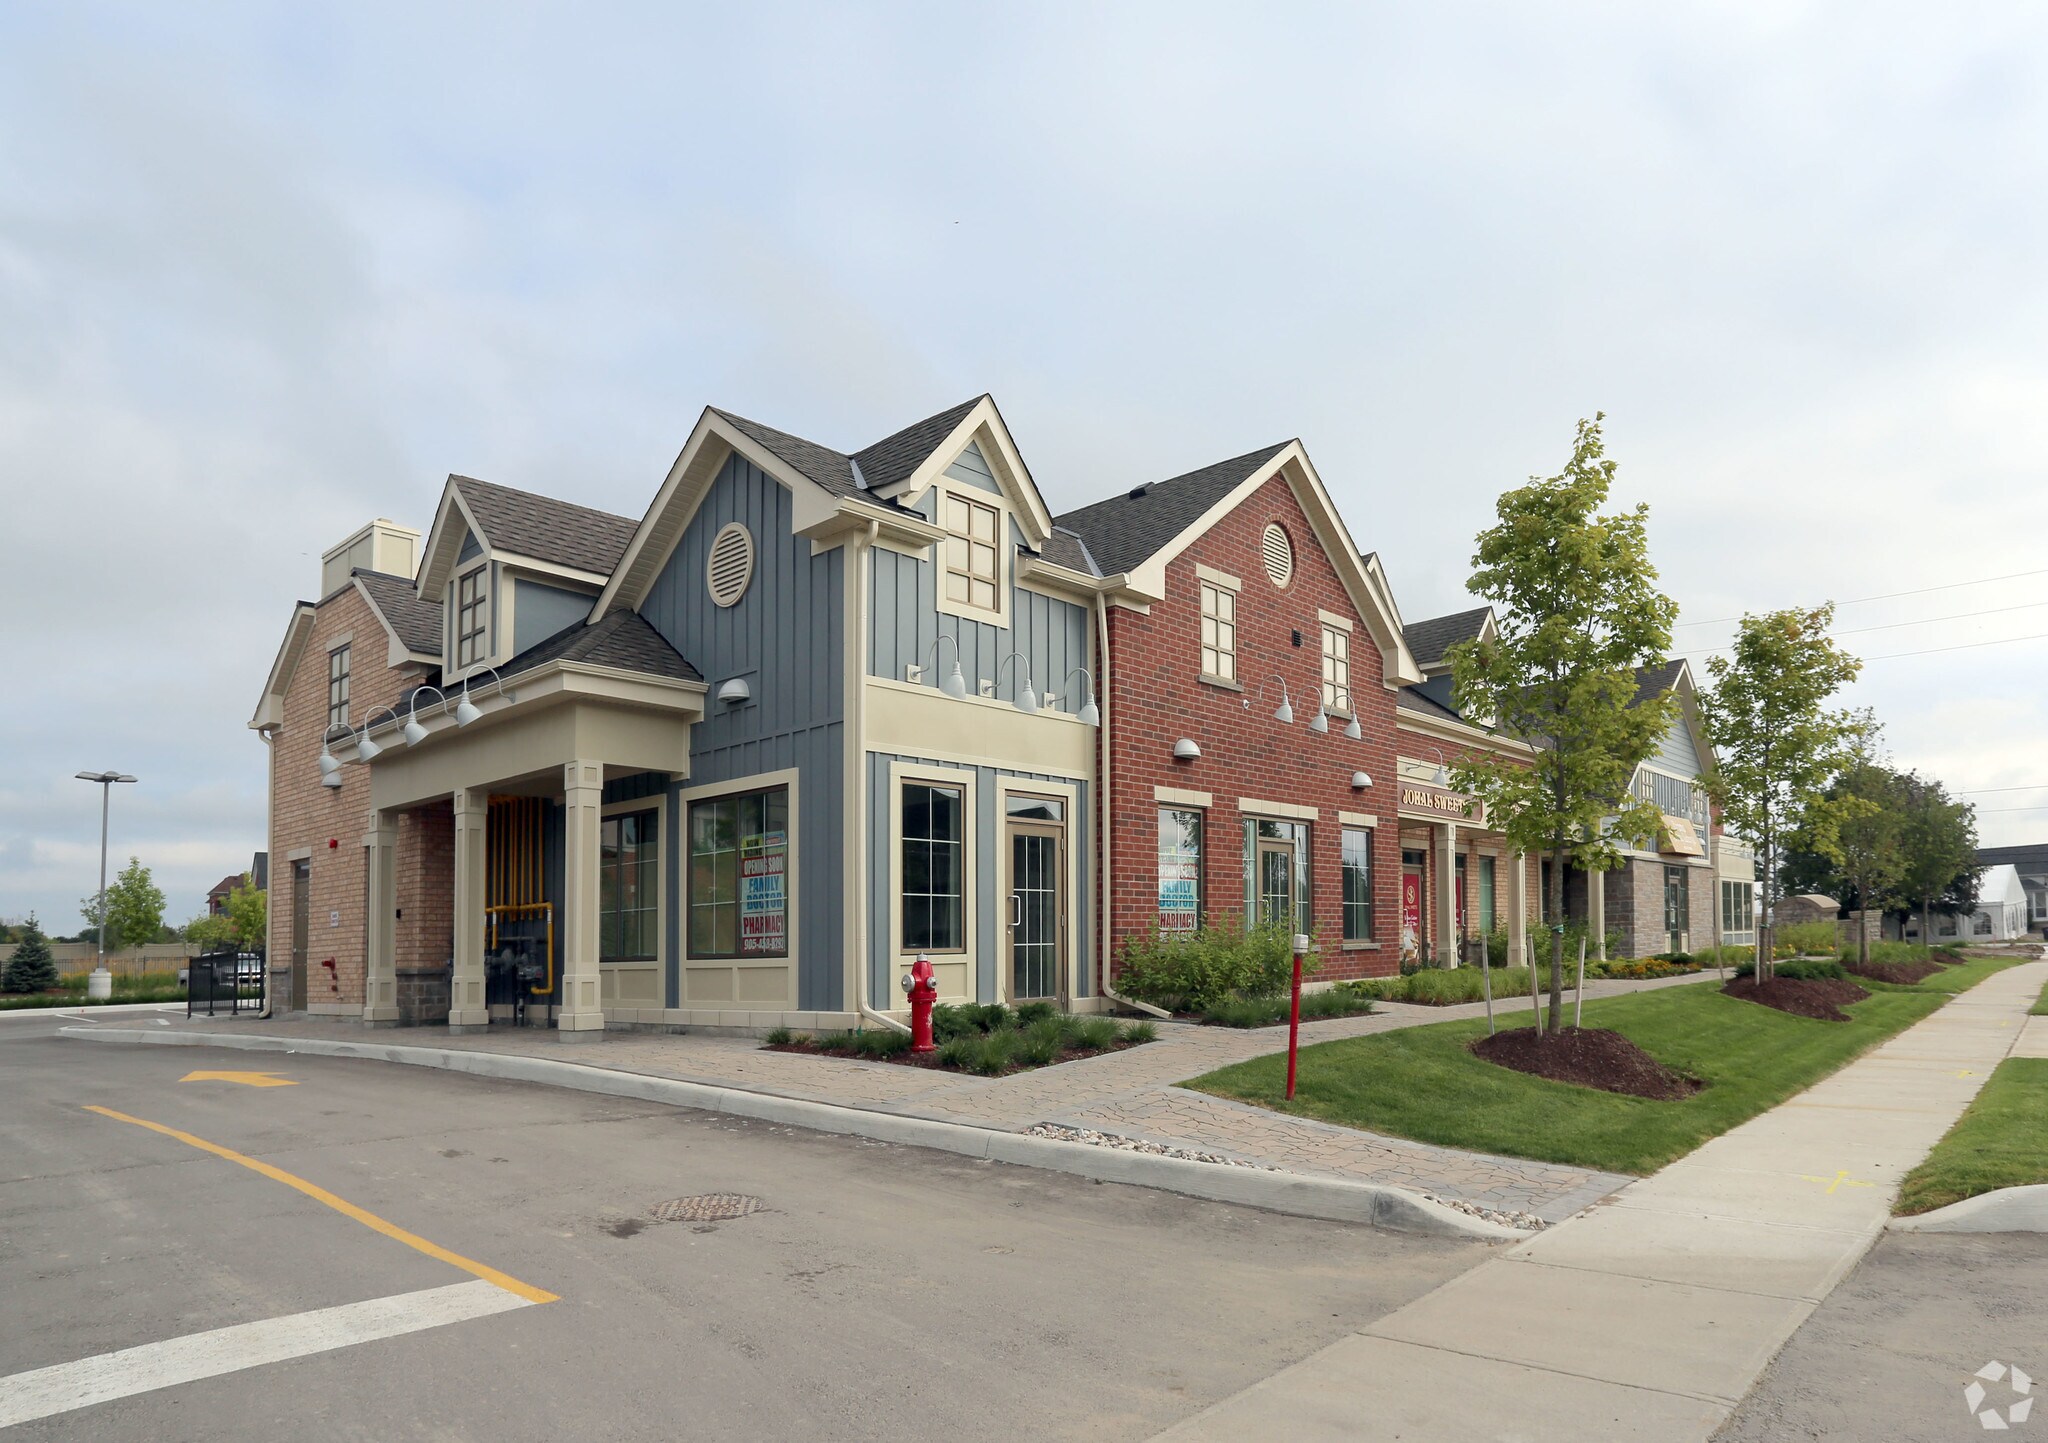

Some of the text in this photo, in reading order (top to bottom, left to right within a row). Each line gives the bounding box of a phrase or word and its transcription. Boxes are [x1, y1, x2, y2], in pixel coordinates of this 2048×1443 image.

[1402, 788, 1433, 808] JOHAL
[749, 875, 780, 893] FAMILY
[747, 892, 783, 910] DOCTOR
[743, 914, 784, 935] PHARMACY
